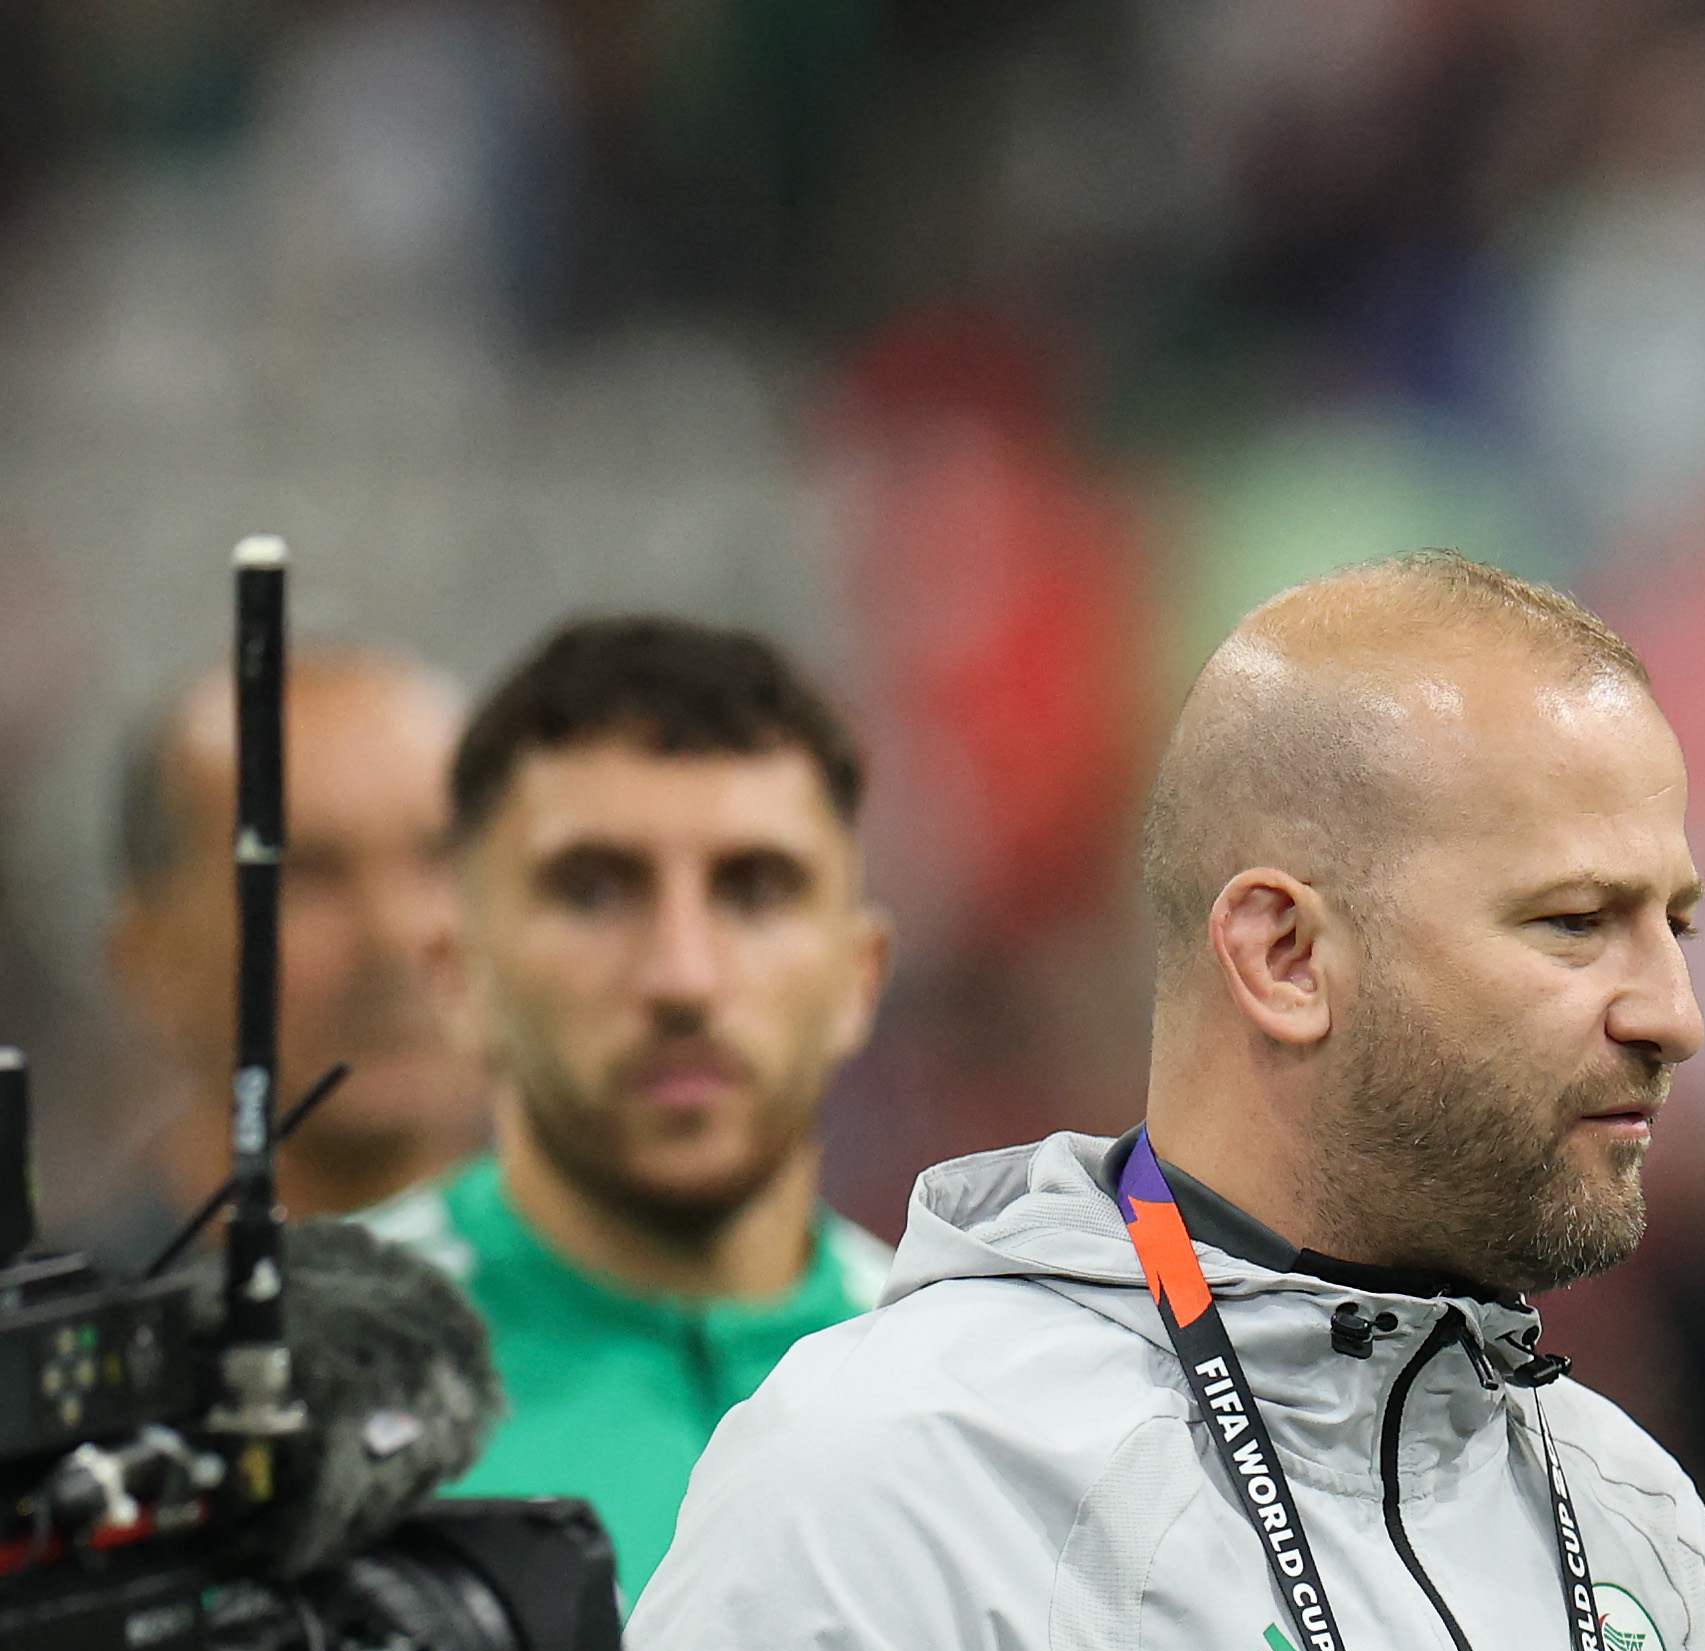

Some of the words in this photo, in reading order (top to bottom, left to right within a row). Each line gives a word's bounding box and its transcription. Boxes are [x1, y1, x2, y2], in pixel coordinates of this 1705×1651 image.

[1195, 1356, 1250, 1443] FIFA
[1232, 1439, 1304, 1577] WORLD
[1558, 1501, 1586, 1578] CUP
